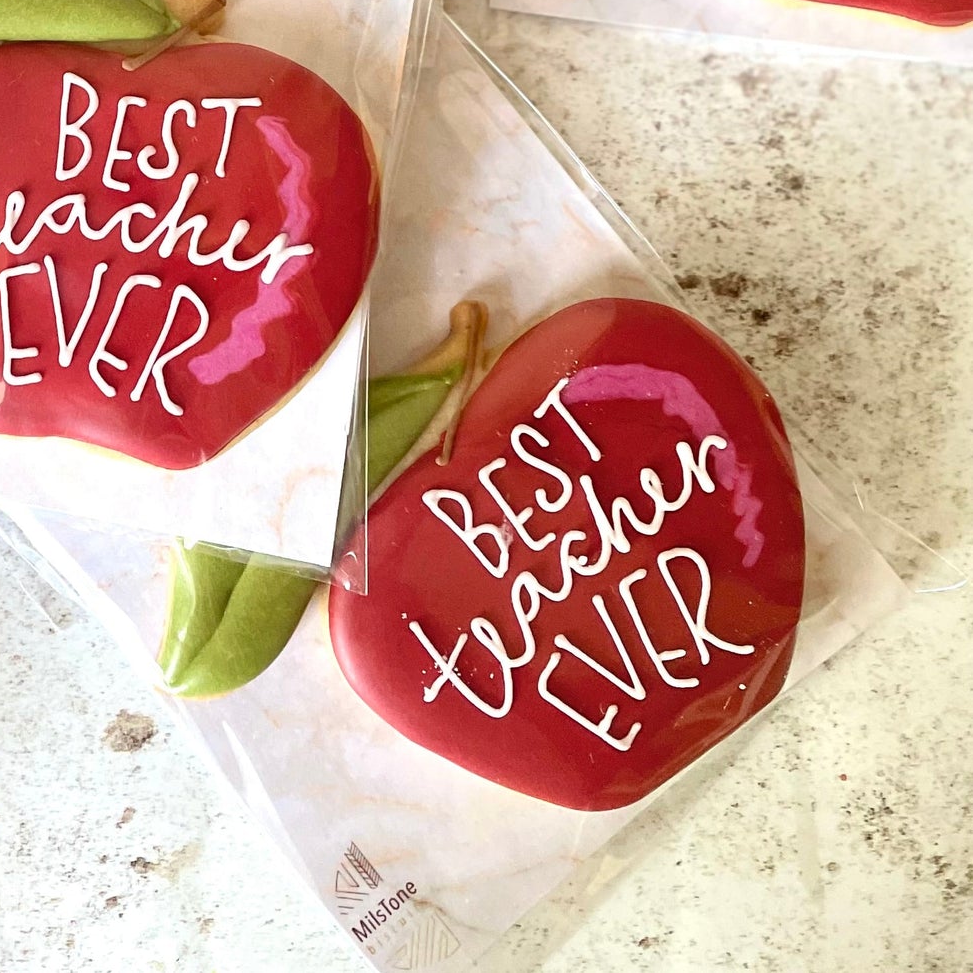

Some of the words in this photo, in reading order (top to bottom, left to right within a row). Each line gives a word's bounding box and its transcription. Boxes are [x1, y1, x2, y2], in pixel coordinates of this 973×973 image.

[55, 71, 263, 192] BEST
[408, 434, 729, 720] teacher
[421, 377, 603, 579] BEST
[537, 547, 755, 752] EVER
[351, 880, 418, 943] MilsTone
